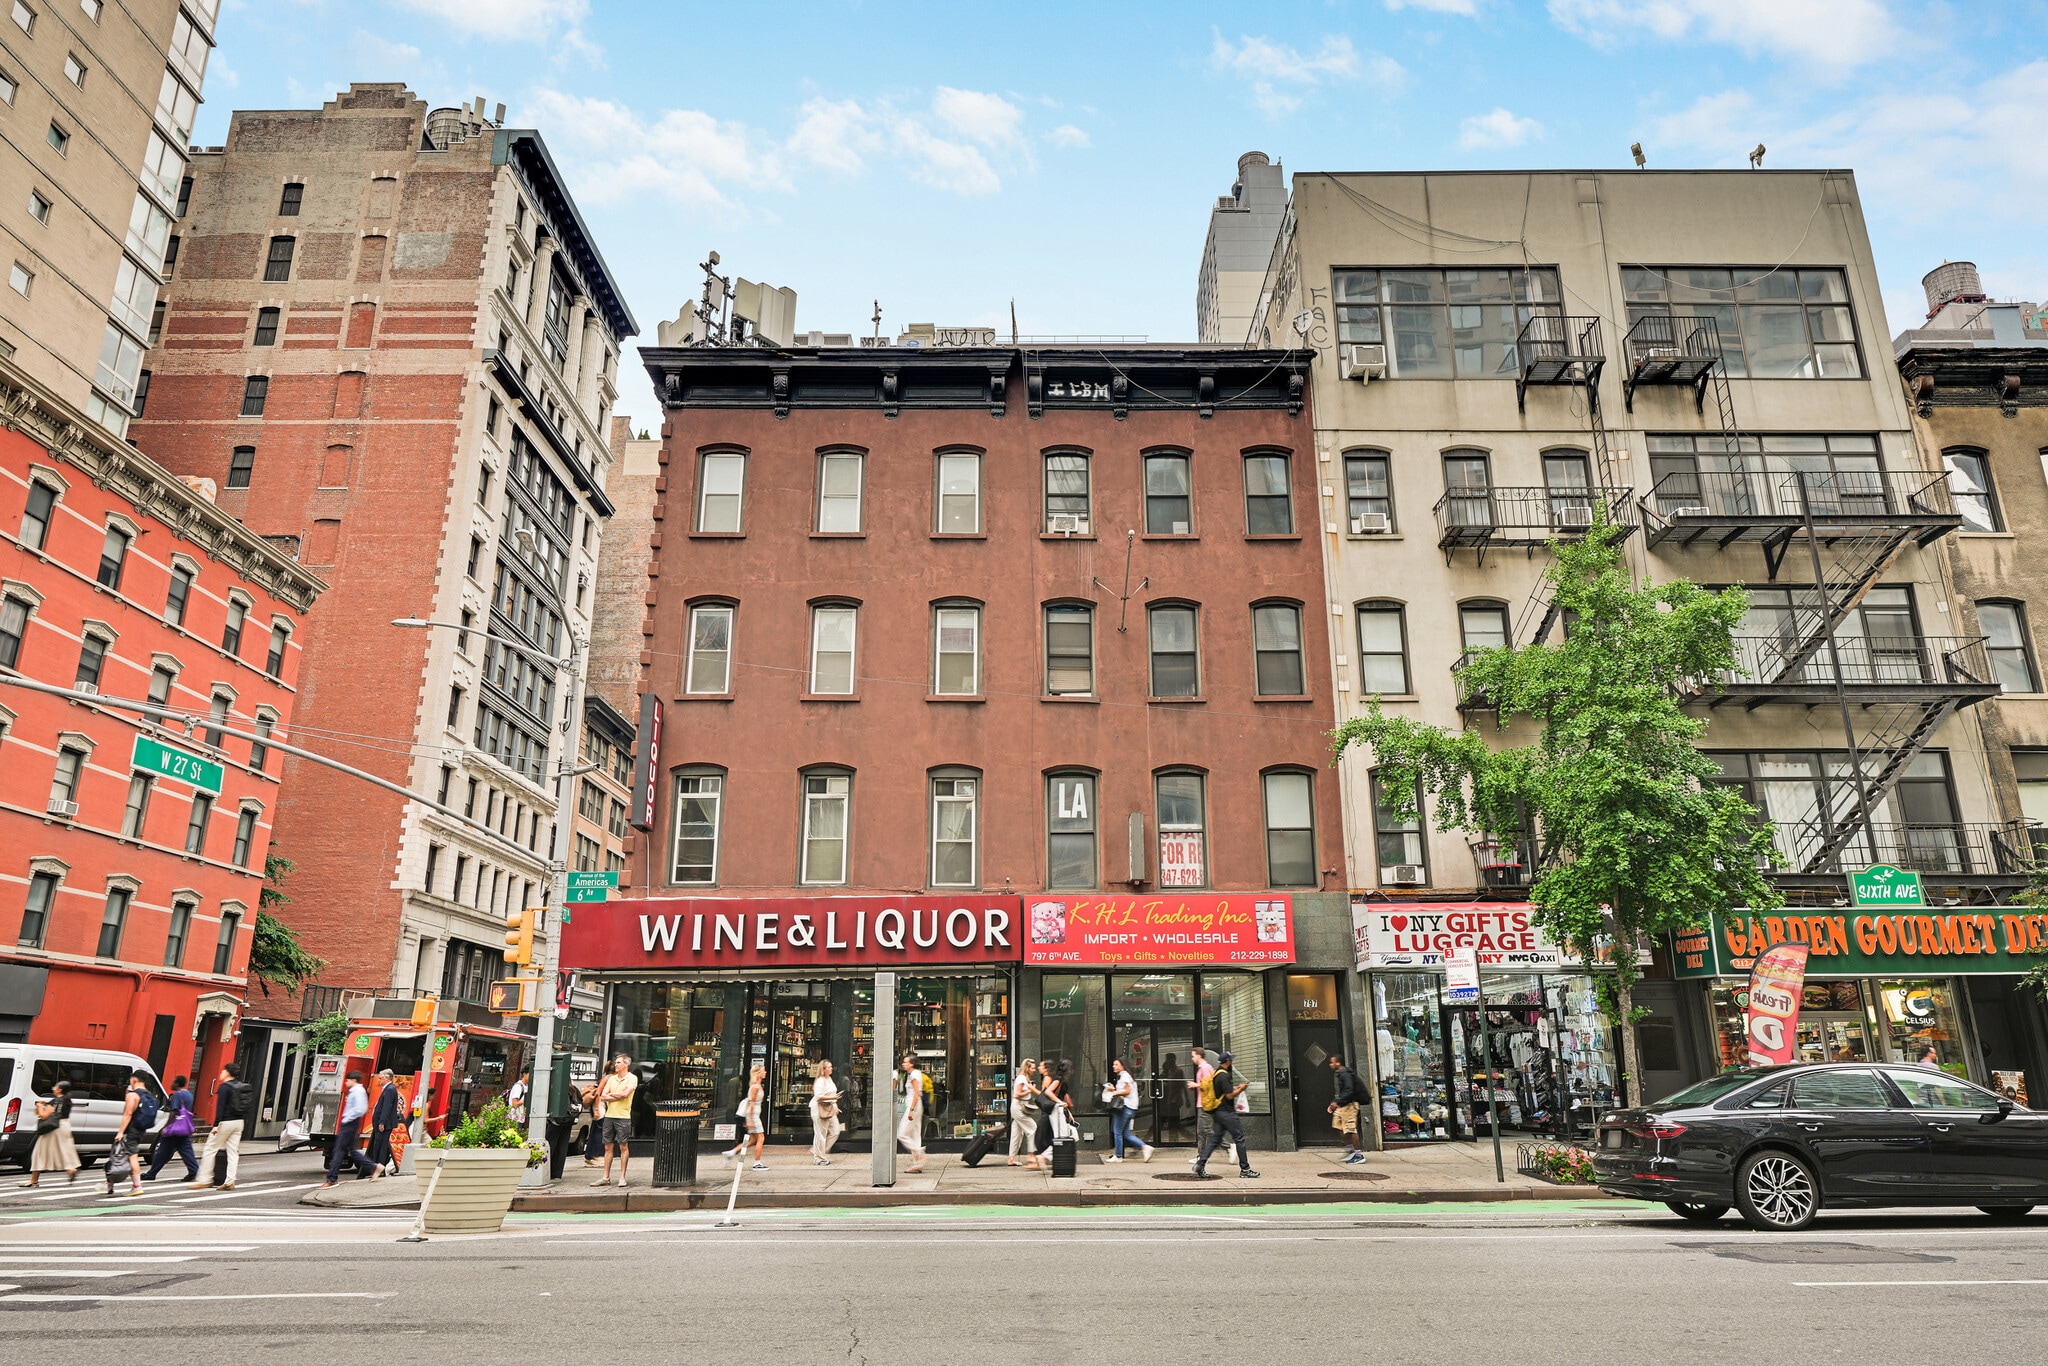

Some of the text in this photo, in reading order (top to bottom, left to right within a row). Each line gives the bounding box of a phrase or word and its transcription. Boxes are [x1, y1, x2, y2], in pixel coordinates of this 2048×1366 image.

[161, 750, 202, 781] W 27 St
[646, 702, 660, 825] LIQUOR
[1058, 782, 1088, 818] LA
[1161, 842, 1184, 864] FOR
[575, 878, 609, 886] Americas
[577, 890, 584, 901] 6
[1858, 884, 1918, 899] SIXTH AVE
[1143, 901, 1214, 931] Trading
[1217, 900, 1253, 926] Inc.
[1380, 912, 1529, 933] I NY GIFTS
[1084, 933, 1239, 944] IMPORT WHOLESALE
[1725, 916, 1850, 956] GARDEN
[1855, 914, 1998, 955] GOURMET
[1394, 933, 1536, 952] LUGGAGE
[1676, 936, 1709, 954] GOURMET
[1032, 952, 1047, 961] 797
[1062, 952, 1082, 961] AVE.
[1100, 951, 1215, 962] Toys Gifts Novelties
[1231, 951, 1288, 960] 212-229-1898
[1422, 955, 1439, 964] NY
[1447, 950, 1453, 958] 3
[1686, 954, 1704, 969] DELI
[772, 985, 791, 994] 795
[1303, 999, 1318, 1007] 797
[1905, 1017, 1936, 1025] CELSIUS
